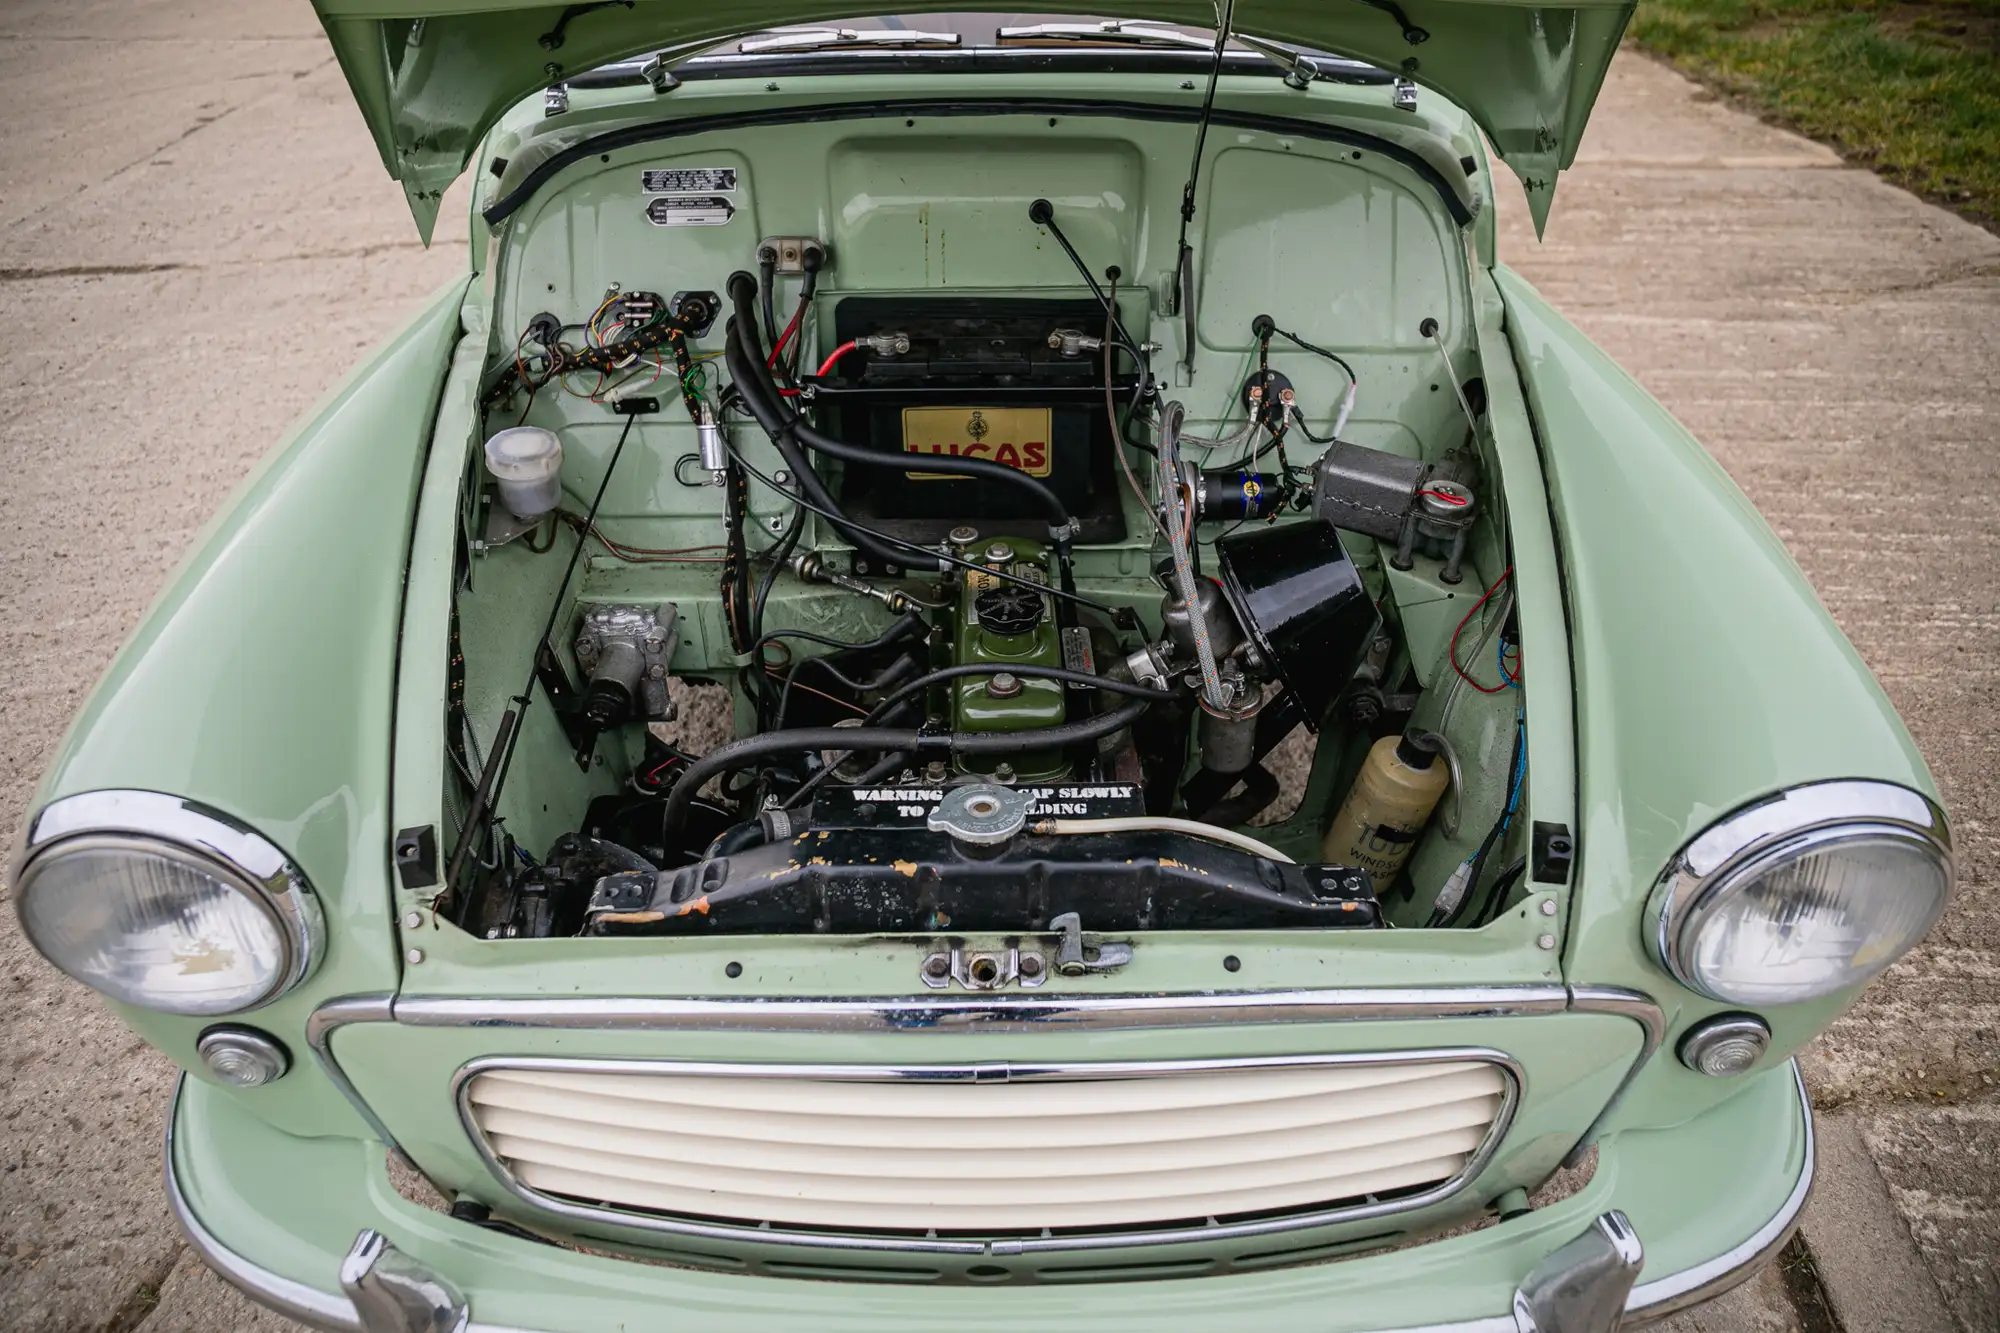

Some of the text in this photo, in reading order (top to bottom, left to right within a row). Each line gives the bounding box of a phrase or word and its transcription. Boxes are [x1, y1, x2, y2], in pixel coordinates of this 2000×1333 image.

[853, 790, 943, 801] WARNING
[1059, 787, 1133, 799] SLOWLY
[897, 805, 924, 817] TO
[1026, 803, 1087, 815] LDING
